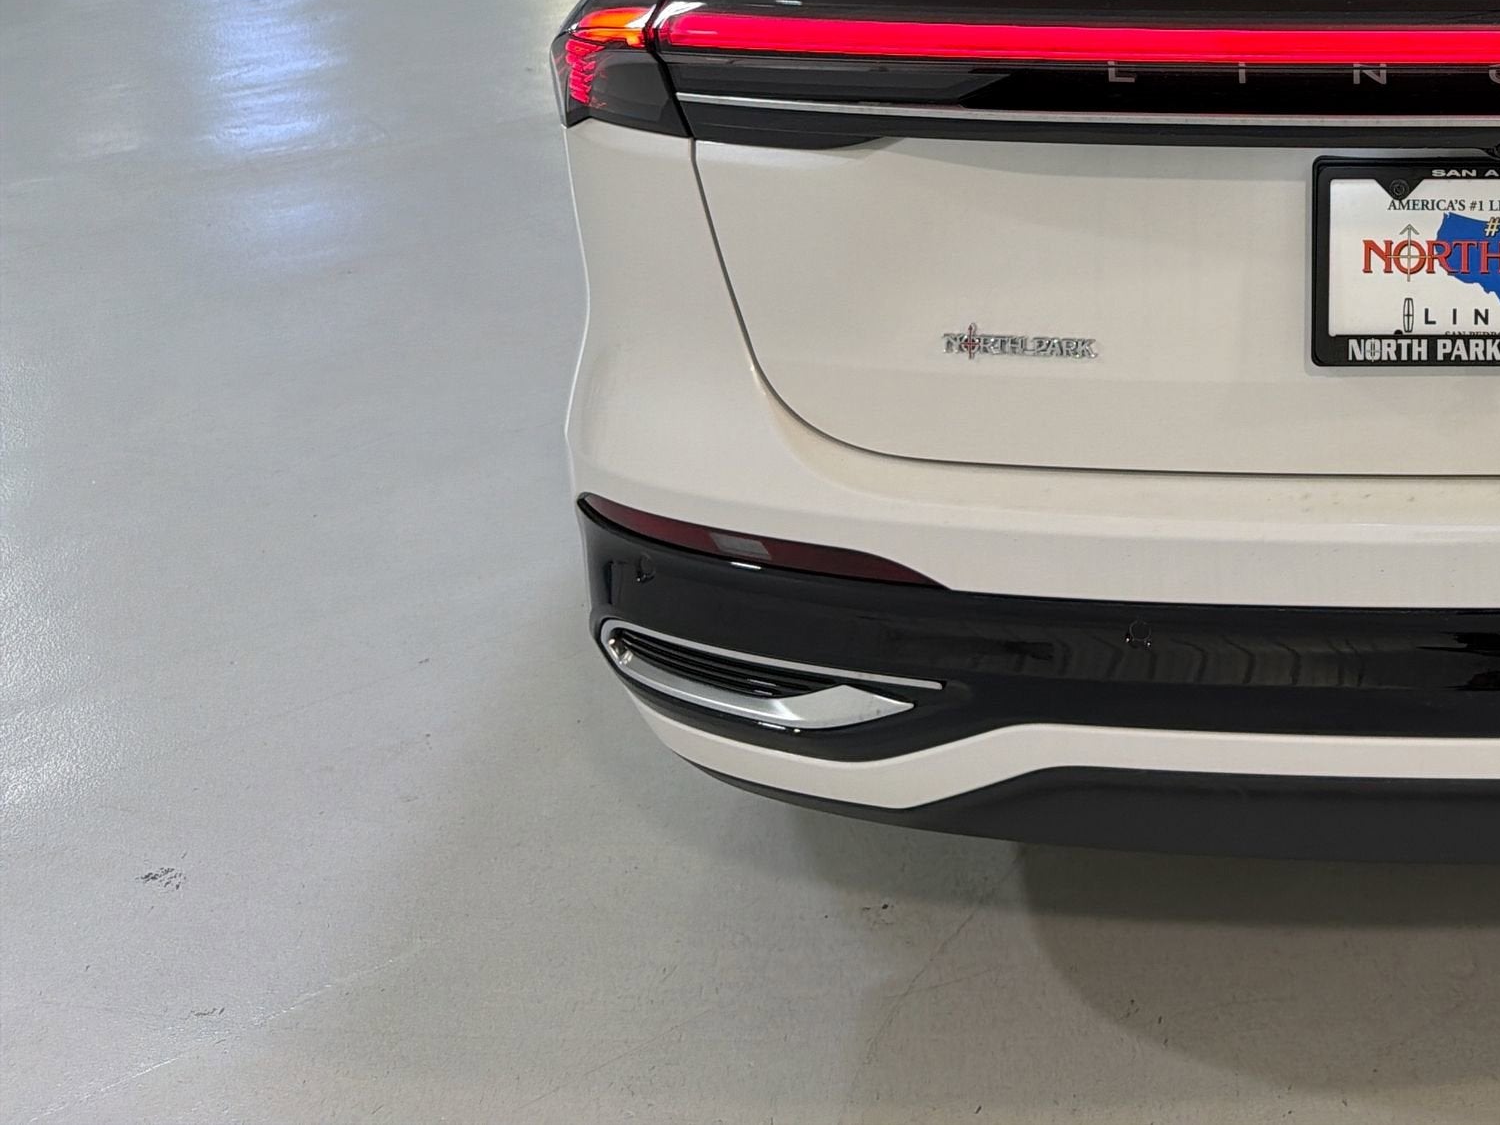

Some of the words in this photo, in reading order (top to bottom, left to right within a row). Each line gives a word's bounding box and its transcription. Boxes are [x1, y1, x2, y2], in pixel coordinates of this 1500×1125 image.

[1431, 169, 1477, 177] SAN
[1388, 199, 1466, 211] AMERICA'S
[1469, 200, 1484, 211] #1
[944, 332, 1026, 356] NORTH
[1031, 336, 1099, 359] PARK
[1348, 338, 1428, 362] NORTH
